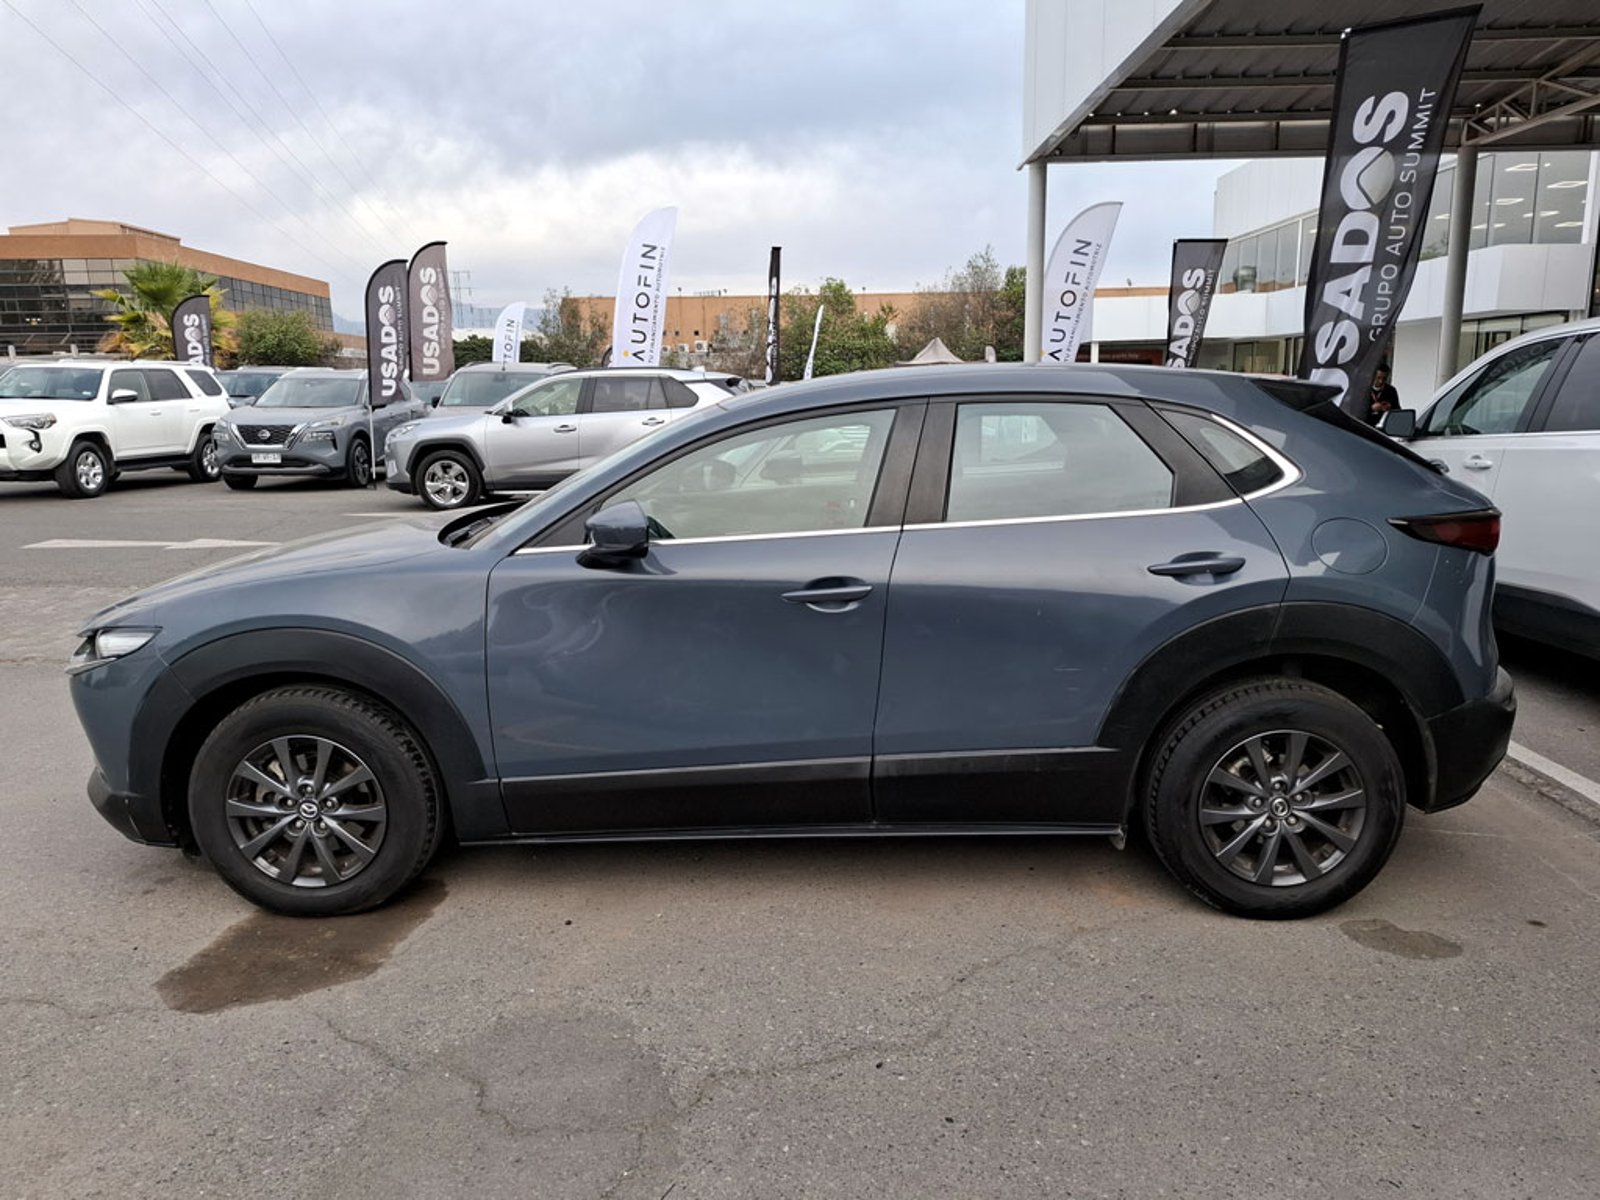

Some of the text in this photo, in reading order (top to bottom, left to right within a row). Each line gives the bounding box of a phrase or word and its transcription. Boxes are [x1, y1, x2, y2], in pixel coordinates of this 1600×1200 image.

[1369, 88, 1436, 342] GRUPO AUTO SUMMIT
[378, 285, 397, 397] USADOS
[420, 267, 440, 375] USADOS
[503, 319, 514, 359] TOFIN
[631, 244, 657, 362] AUTOFIN
[1048, 238, 1092, 361] AUTOFIN
[1166, 268, 1205, 368] SADOS
